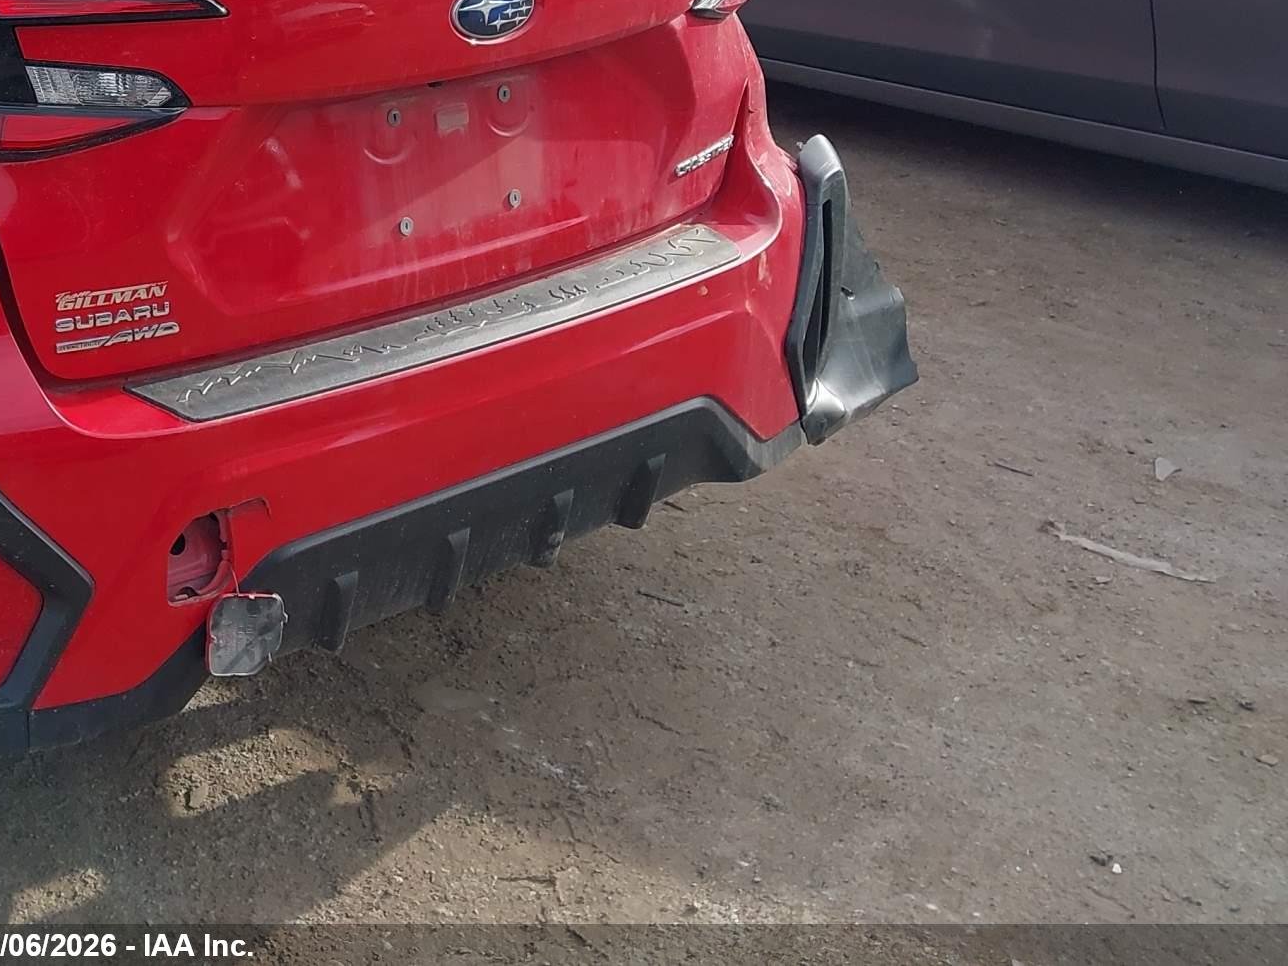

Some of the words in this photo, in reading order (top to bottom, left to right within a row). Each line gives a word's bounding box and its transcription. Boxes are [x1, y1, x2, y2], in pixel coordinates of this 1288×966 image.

[57, 283, 168, 311] GILLMAN
[55, 301, 170, 333] SUBARU
[104, 321, 180, 347] AWD
